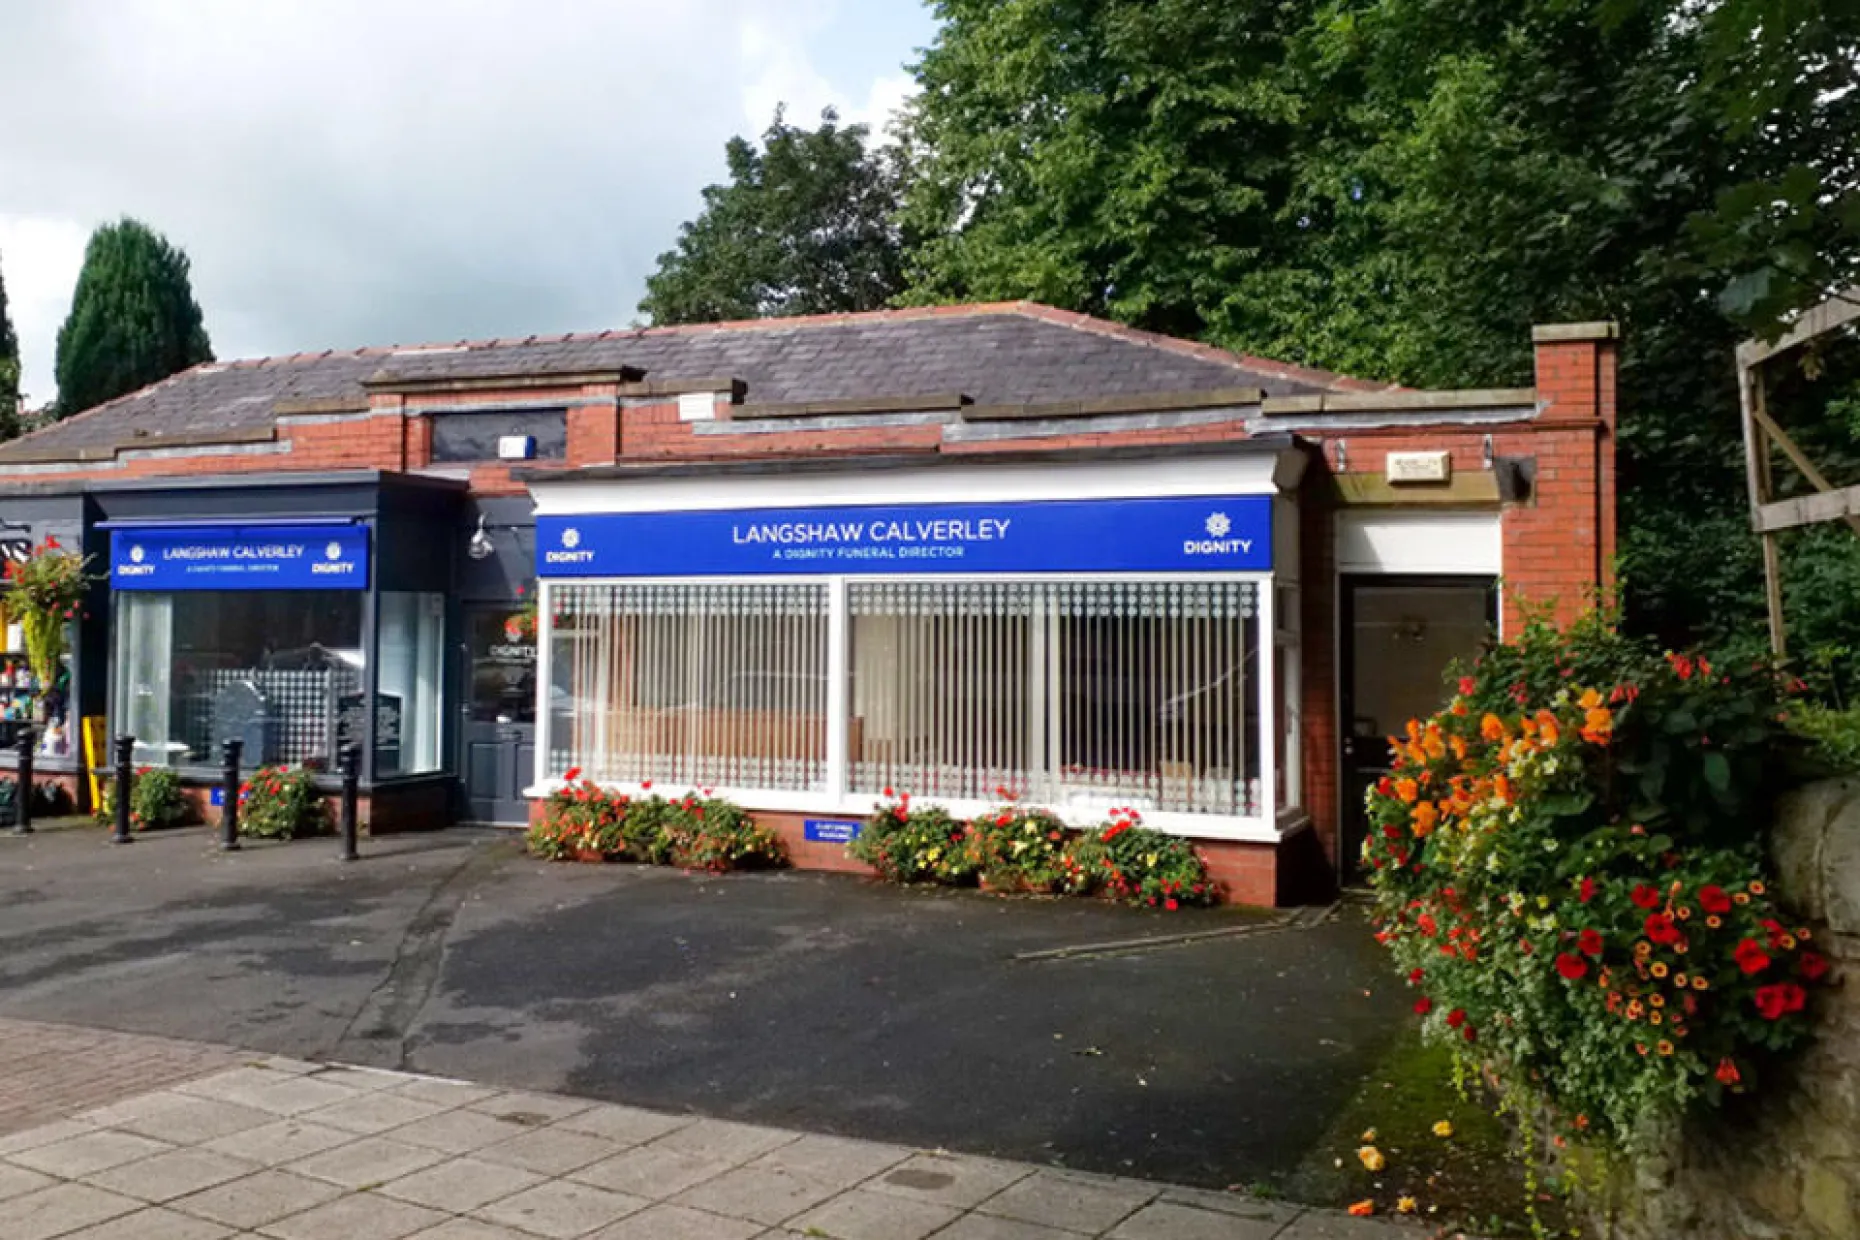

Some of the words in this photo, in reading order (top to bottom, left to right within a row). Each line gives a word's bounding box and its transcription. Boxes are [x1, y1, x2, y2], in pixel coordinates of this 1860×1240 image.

[732, 523, 863, 543] LANGSHAW
[869, 519, 1010, 541] CALVERLEY
[163, 546, 230, 560] LANGSHAW
[232, 544, 304, 559] CALVERLEY
[773, 548, 781, 558] A
[784, 547, 834, 559] DIGNITY
[837, 546, 895, 558] FUNERAL
[898, 545, 964, 558] DIRECTOR
[1183, 540, 1252, 555] DIGNITY
[545, 551, 595, 563] DIGNITY
[117, 564, 155, 576] DIGNITY
[311, 562, 355, 574] DIGNITY
